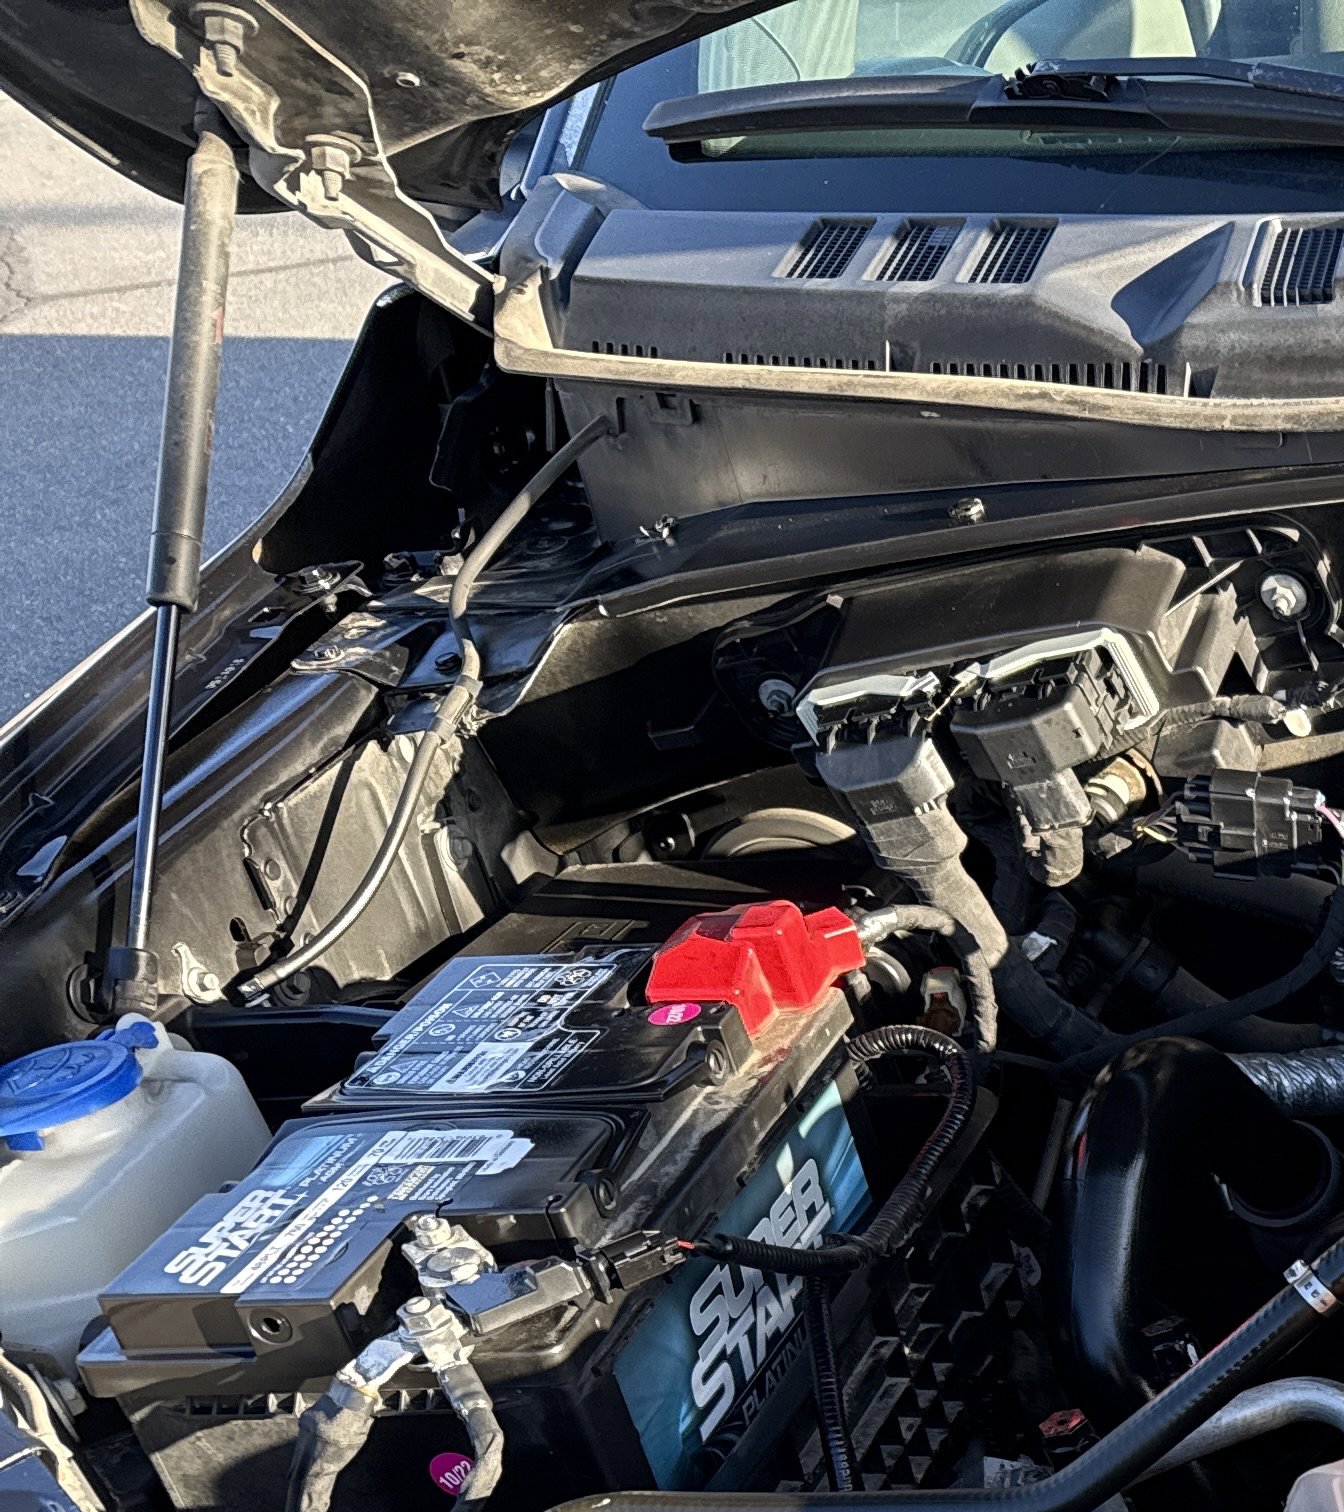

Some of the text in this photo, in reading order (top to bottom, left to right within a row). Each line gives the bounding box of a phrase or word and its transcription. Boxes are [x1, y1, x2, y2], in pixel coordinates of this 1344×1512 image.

[300, 1135, 358, 1189] PLATINUM
[164, 1188, 275, 1275] SUPER
[179, 1188, 289, 1287] START
[690, 1157, 826, 1356] SUPER
[742, 1326, 804, 1428] PLATIN
